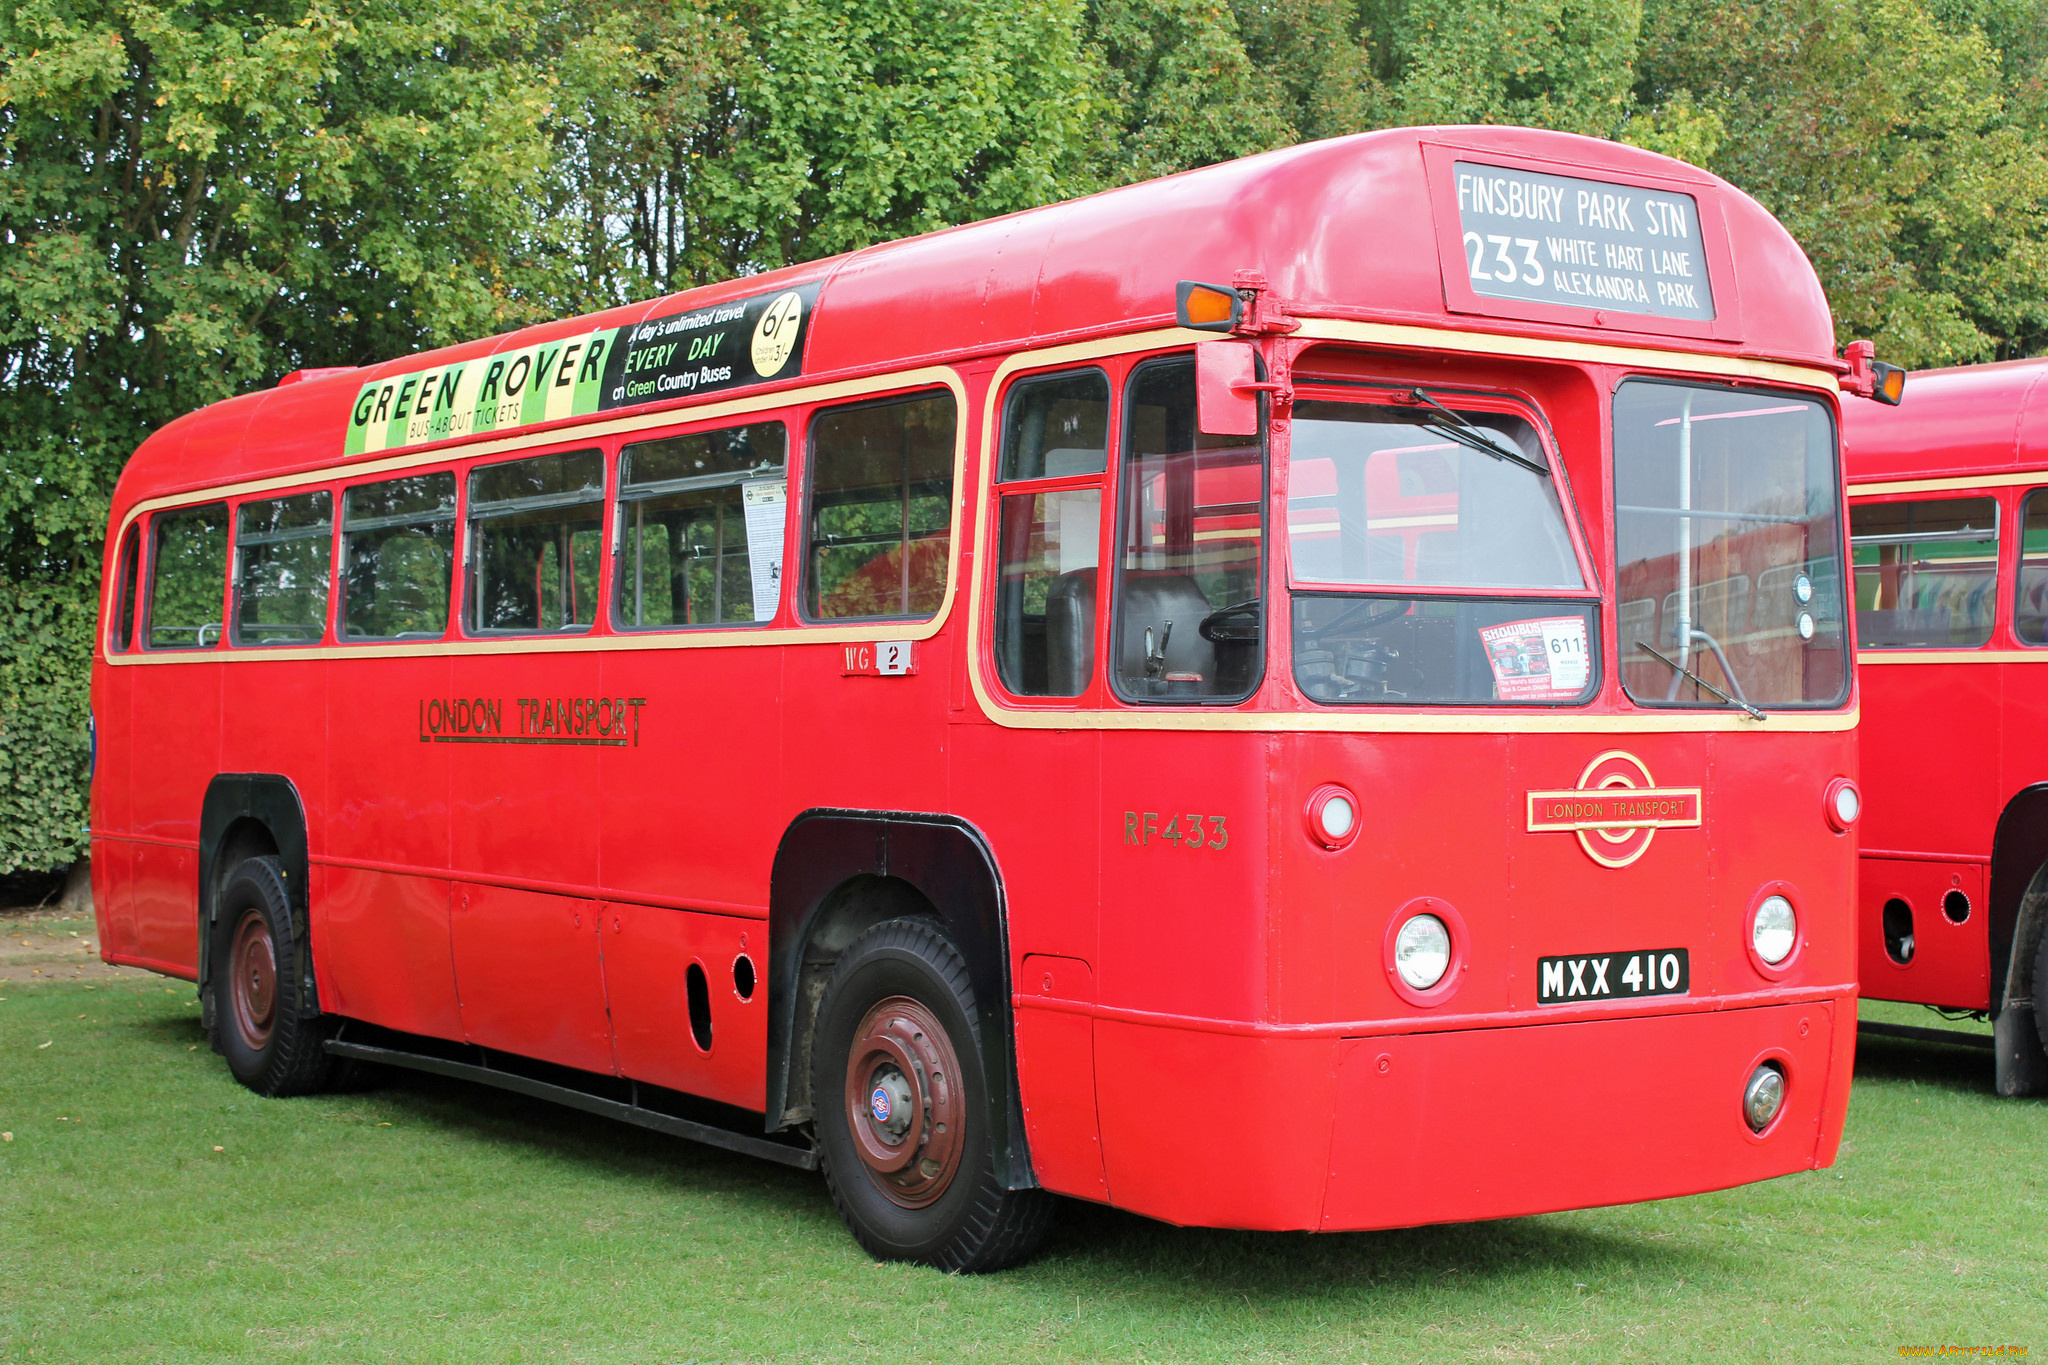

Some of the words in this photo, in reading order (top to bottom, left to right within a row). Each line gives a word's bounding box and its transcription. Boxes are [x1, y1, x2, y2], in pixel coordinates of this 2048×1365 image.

[1459, 174, 1564, 222] FINSBURY
[1577, 190, 1635, 232] PARK
[1645, 200, 1688, 238] STN
[1463, 231, 1545, 286] 233
[1546, 236, 1599, 267] WHITE
[1605, 243, 1644, 272] HART
[1651, 249, 1693, 278] LANE
[1553, 269, 1650, 304] ALEXANDRA
[1657, 281, 1700, 309] PARK
[628, 327, 639, 343] A
[638, 321, 665, 343] day's
[665, 308, 714, 334] unlimited
[714, 302, 747, 324] travel
[625, 342, 678, 374] EVERY
[688, 333, 725, 361] DAY
[354, 369, 463, 427] GREEN
[481, 339, 606, 402] ROVER
[612, 386, 625, 401] on
[626, 379, 656, 398] Green
[657, 370, 699, 392] Country
[699, 366, 731, 384] Buses
[410, 411, 472, 438] BUS-ABOUT
[475, 402, 520, 427] TICKETS
[1482, 622, 1542, 641] SHOWBUS
[1551, 637, 1581, 653] 611
[845, 647, 869, 670] WG
[888, 646, 899, 670] 2
[419, 698, 501, 742] LONDON
[517, 697, 647, 747] TRANSPORT
[1546, 803, 1604, 819] LONDON
[1612, 800, 1686, 816] TRANSPORT
[1124, 811, 1228, 850] RF433
[1542, 957, 1611, 998] MXX
[1621, 953, 1681, 992] 410
